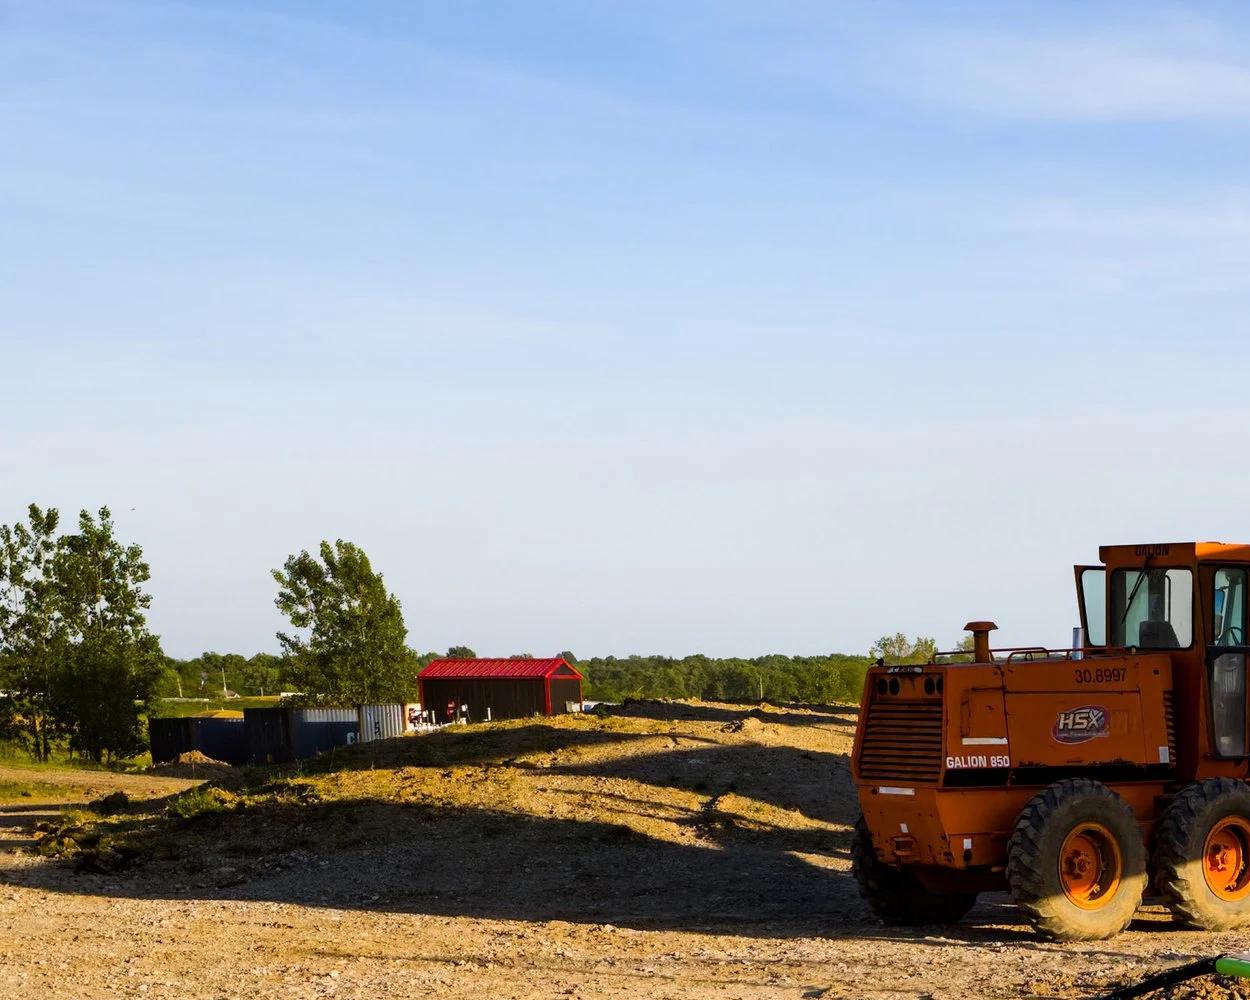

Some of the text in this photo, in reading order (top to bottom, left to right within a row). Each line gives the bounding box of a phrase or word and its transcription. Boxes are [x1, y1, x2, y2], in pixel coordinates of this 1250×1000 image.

[1075, 668, 1127, 684] 30.8997
[1058, 709, 1104, 731] HSX
[946, 755, 1010, 769] GALION 850
